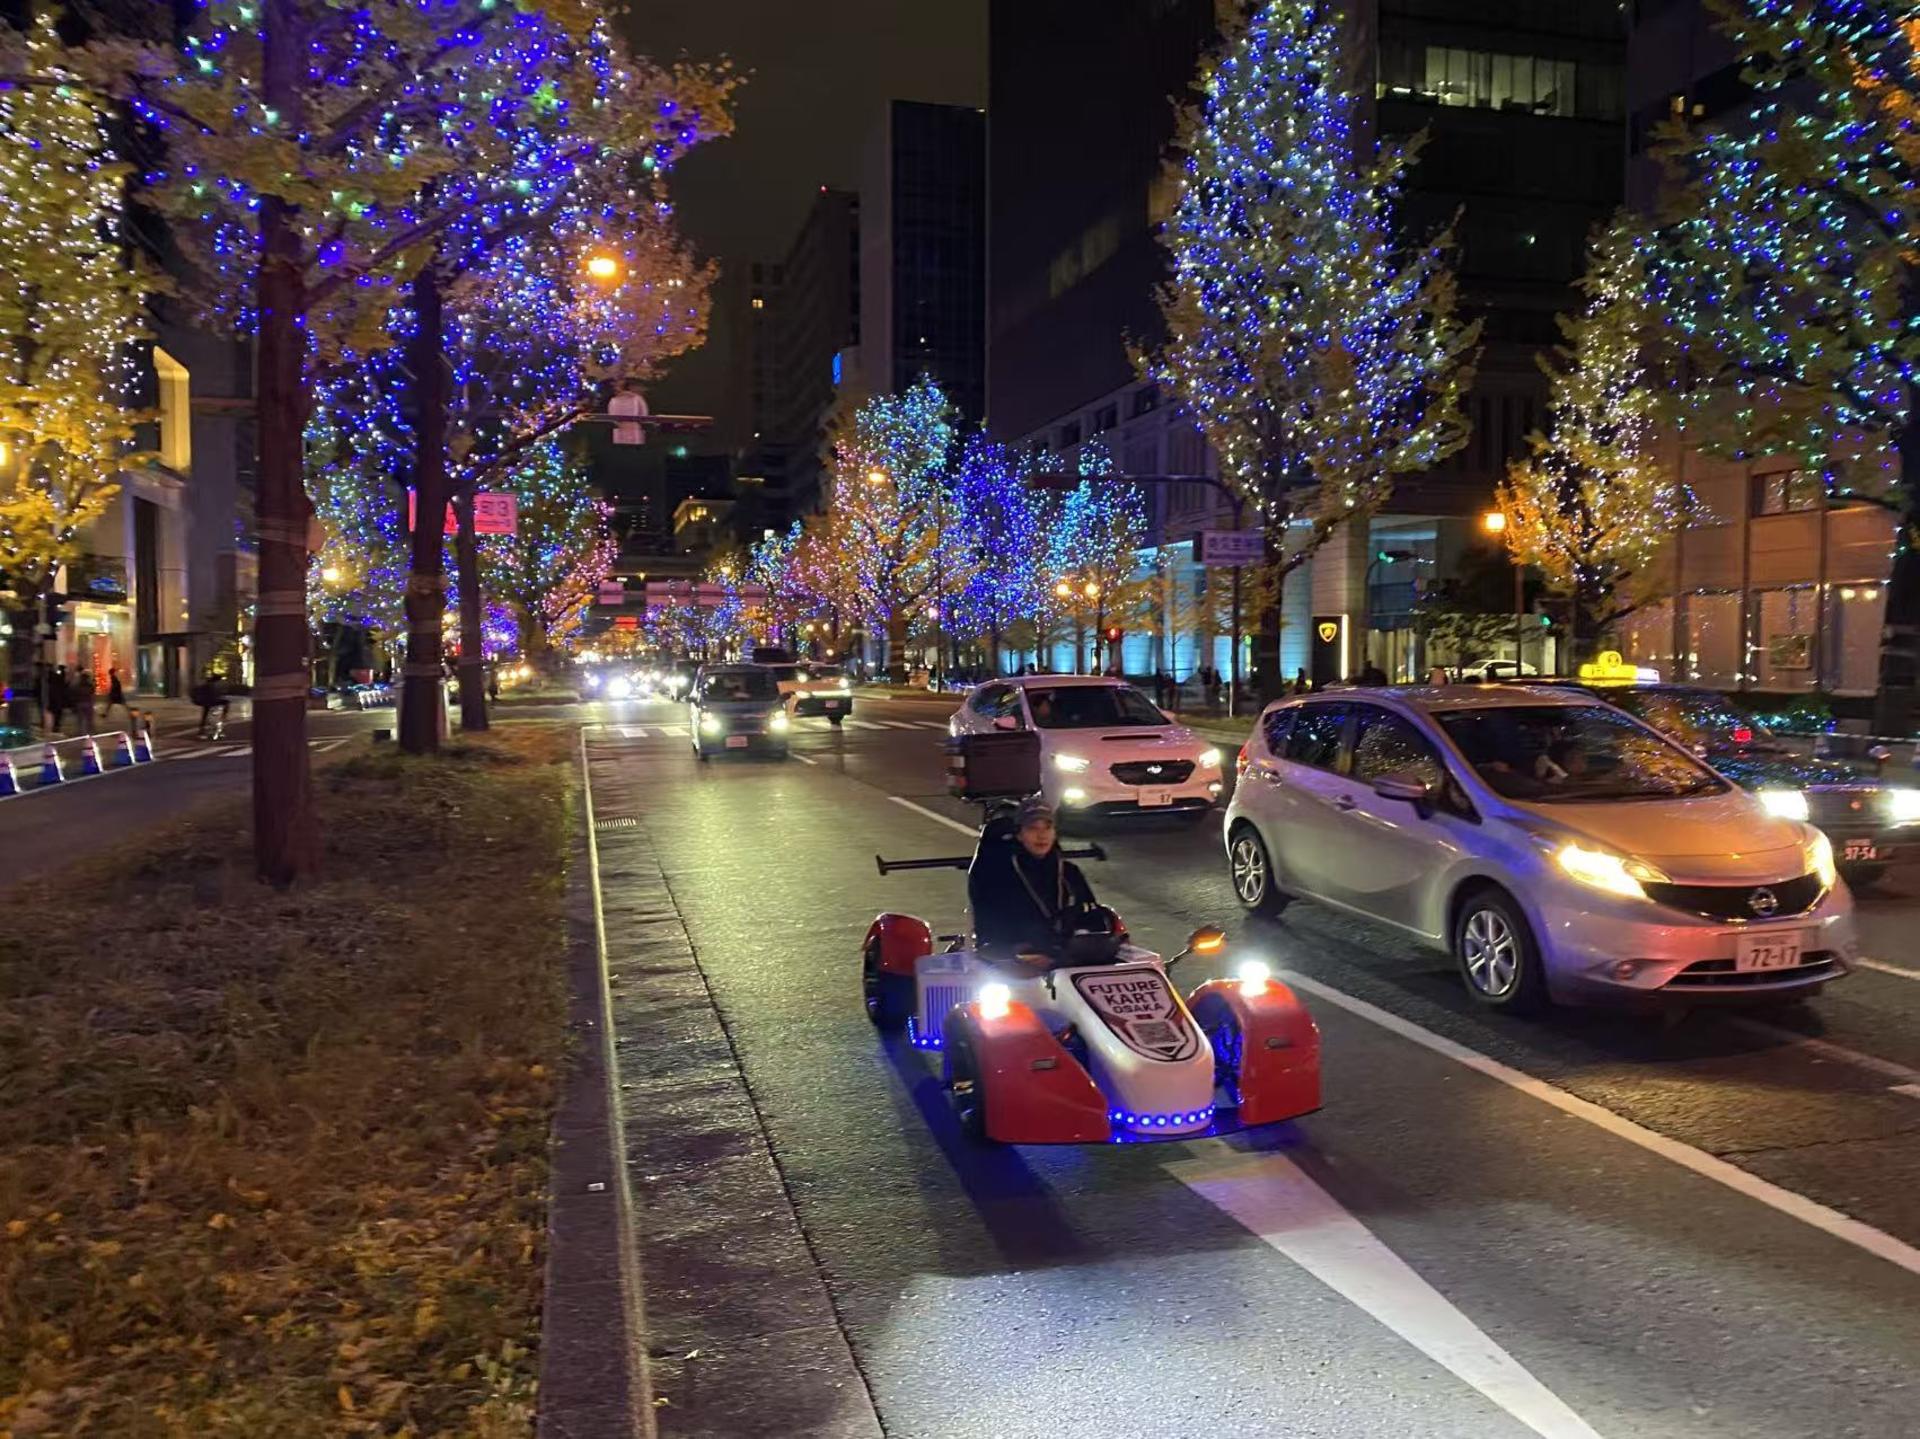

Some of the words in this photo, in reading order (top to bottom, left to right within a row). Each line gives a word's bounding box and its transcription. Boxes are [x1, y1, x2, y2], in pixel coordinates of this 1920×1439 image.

[1750, 946, 1798, 967] 72-17
[1088, 980, 1161, 994] FUTURE
[1105, 992, 1158, 1005] KART
[1112, 1003, 1163, 1013] OSAKA
